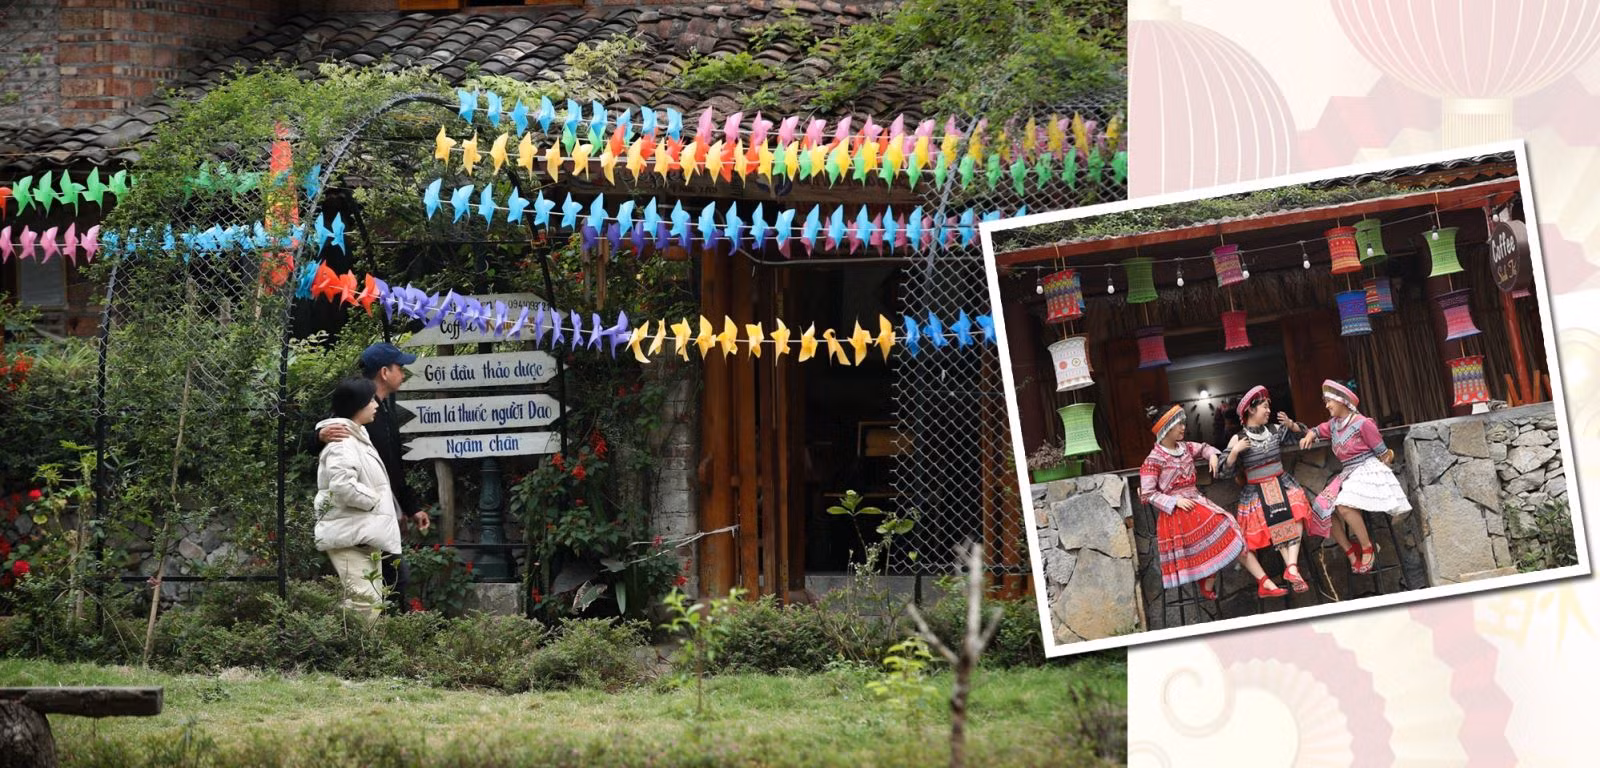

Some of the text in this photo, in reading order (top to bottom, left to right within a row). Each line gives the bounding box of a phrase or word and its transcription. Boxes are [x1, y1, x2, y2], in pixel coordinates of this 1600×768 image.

[1491, 232, 1516, 264] Coffee
[424, 360, 544, 384] Gội đầu thảo dược
[444, 404, 456, 424] lá
[458, 403, 488, 423] thuốc
[491, 401, 523, 426] người
[528, 400, 552, 420] Dao
[446, 435, 519, 458] Ngâm chân
